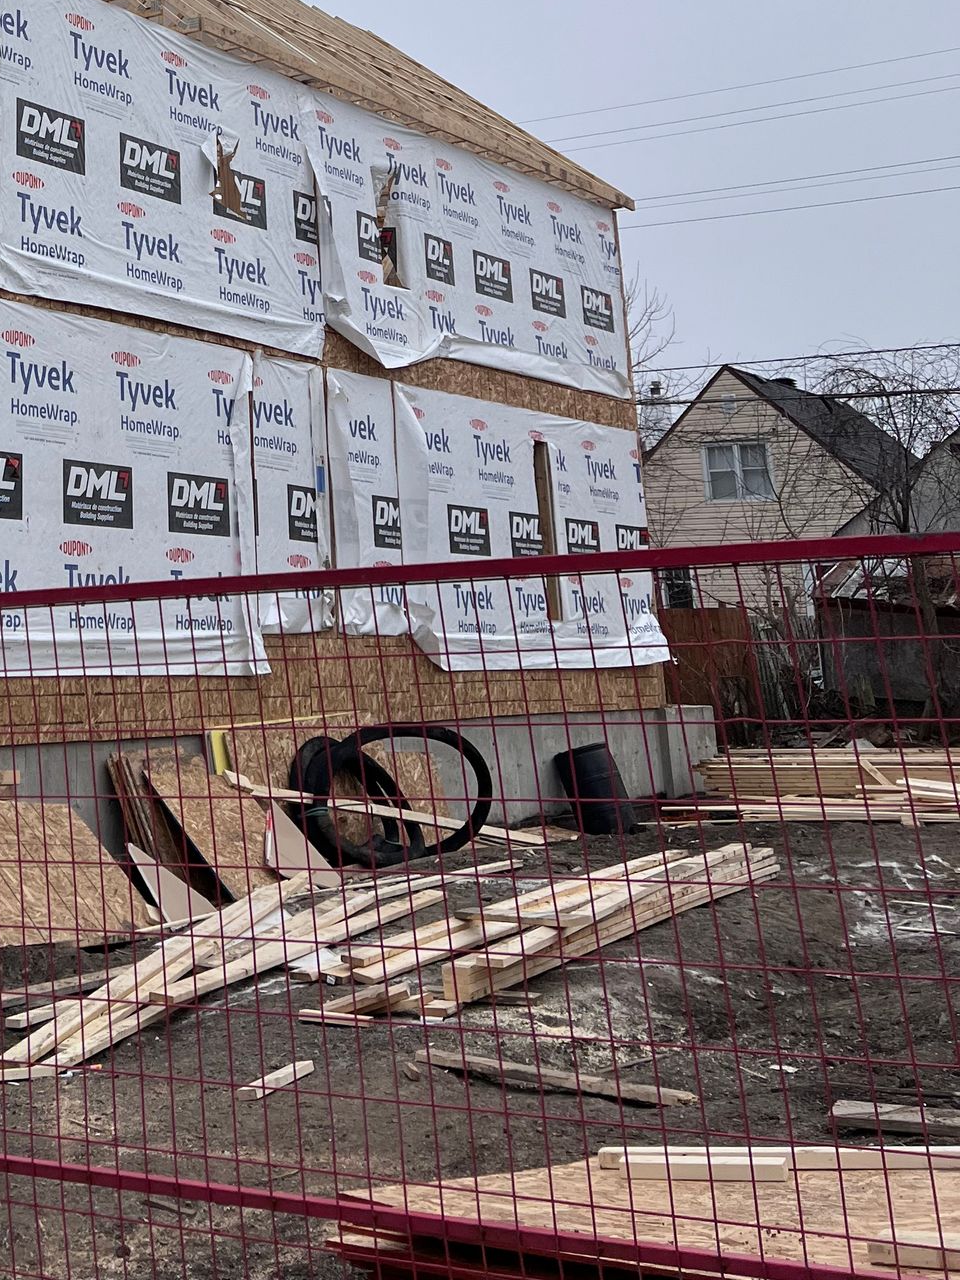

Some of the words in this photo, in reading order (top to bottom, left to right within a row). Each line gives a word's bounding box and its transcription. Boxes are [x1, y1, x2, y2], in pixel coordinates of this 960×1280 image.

[68, 13, 92, 30] DUPONT
[70, 31, 129, 76] Tyvek
[74, 72, 132, 105] HomeWrap
[165, 69, 219, 111] Tyvek
[20, 106, 78, 149] DML
[251, 101, 299, 141] Tyvek
[256, 137, 301, 166] HomeWrap
[318, 126, 360, 163] Tyvek
[123, 140, 175, 180] DML
[386, 152, 428, 187] Tyvek
[16, 172, 41, 189] DUPONT
[438, 173, 475, 205] Tyvek
[120, 202, 144, 218] DUPONT
[389, 190, 431, 211] omeWrap
[497, 195, 531, 226] Tyvek
[17, 192, 82, 237] Tyvek
[443, 205, 478, 227] HomeWrap
[122, 221, 180, 264] Tyvek
[502, 225, 535, 247] HomeWrap
[550, 215, 581, 244] Tyvek
[21, 236, 85, 268] HomeWrap
[599, 234, 616, 260] Tyv
[127, 263, 182, 291] HomeWrap
[214, 247, 267, 286] Tyvek
[476, 256, 508, 283] DML
[220, 286, 270, 313] HomeWrap
[533, 273, 561, 300] DML
[361, 287, 403, 320] Tyvek
[584, 290, 610, 315] DML
[5, 330, 32, 347] DUPONT
[366, 323, 407, 346] HomeWrap
[479, 320, 514, 347] Tyvek
[6, 352, 74, 394] Tyvek
[115, 352, 138, 367] DUPONT
[116, 371, 176, 411] Tyvek
[11, 398, 78, 426] HomeWrap
[254, 400, 294, 428] yvek
[121, 415, 179, 441] HomeWrap
[349, 415, 377, 441] vek
[425, 429, 451, 453] vek
[255, 435, 297, 456] omeWrap
[473, 435, 511, 465] Tyvek
[348, 451, 379, 468] meWrap
[585, 455, 616, 482] Tyvek
[67, 466, 126, 501] DML
[479, 469, 514, 487] HomeWrap
[171, 478, 223, 511] DML
[291, 493, 316, 517] DM
[375, 501, 400, 527] DM
[451, 509, 486, 536] DML
[569, 522, 598, 546] DML
[618, 528, 648, 549] DML
[63, 541, 89, 557] DUPONT
[169, 548, 191, 563] DUPONT
[453, 584, 493, 616] Tyvek
[515, 587, 545, 617] Tyve
[69, 612, 134, 633] HomeWrap
[176, 615, 232, 633] HomeWrap
